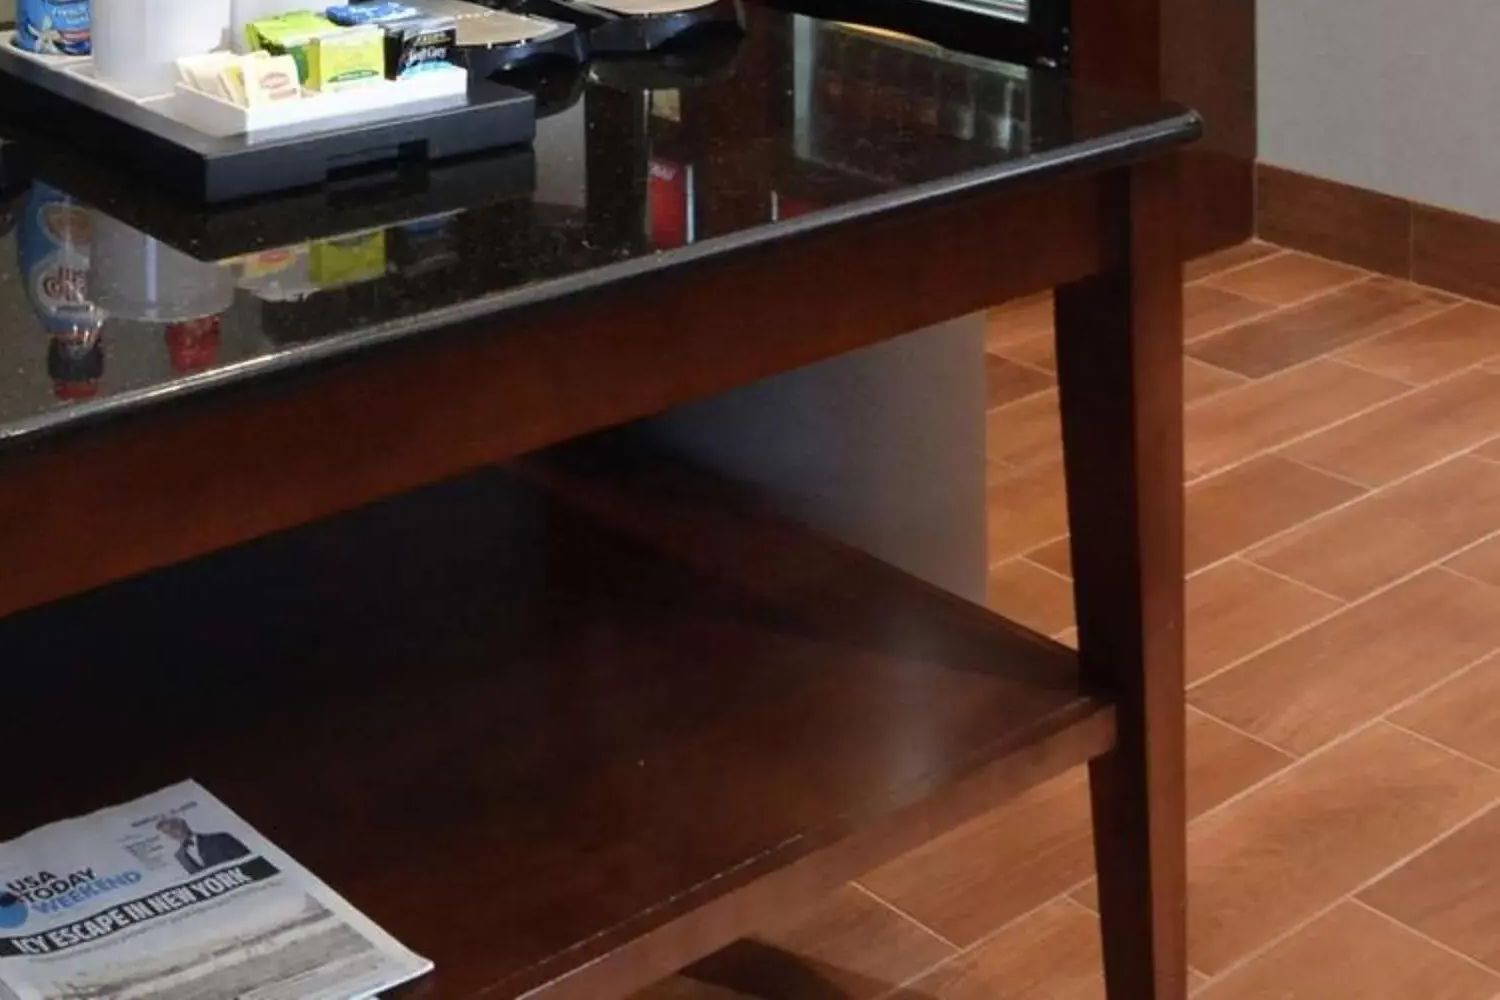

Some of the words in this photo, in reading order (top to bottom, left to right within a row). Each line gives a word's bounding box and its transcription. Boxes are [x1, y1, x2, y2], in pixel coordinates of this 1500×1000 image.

[5, 871, 58, 894] USA
[23, 866, 96, 903] TODAY
[30, 871, 142, 914] WEEKEND
[11, 936, 50, 955] ICY
[48, 907, 131, 948] ESCAPE
[122, 899, 156, 921] IN
[147, 885, 198, 914] NEW
[189, 866, 252, 898] YORK
